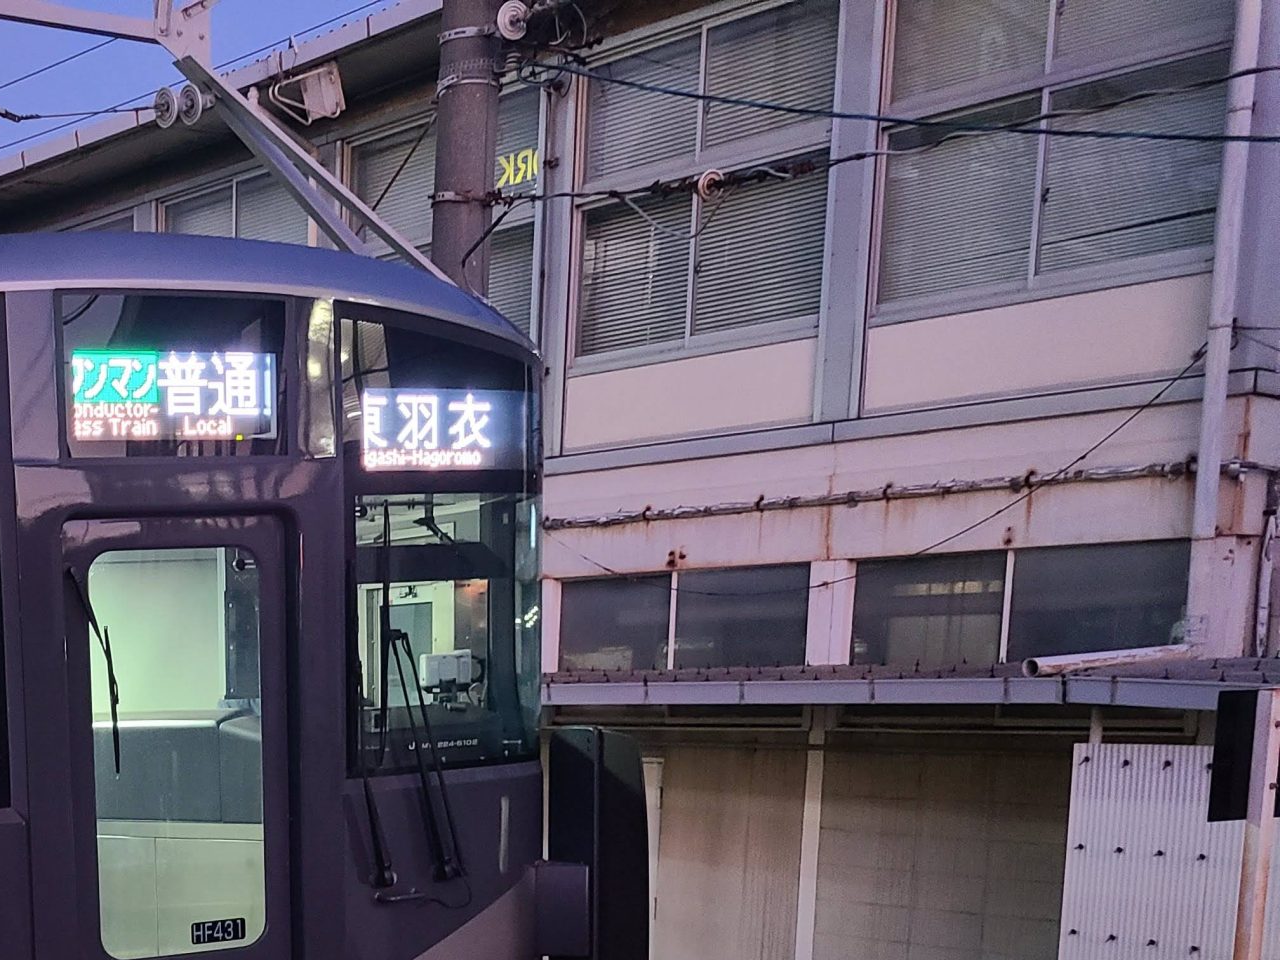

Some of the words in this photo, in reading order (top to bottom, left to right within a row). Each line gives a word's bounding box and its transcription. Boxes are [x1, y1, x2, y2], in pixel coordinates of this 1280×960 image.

[158, 350, 262, 416] 普通
[108, 418, 158, 436] Train
[184, 415, 233, 436] Local
[193, 919, 242, 943] HF431
